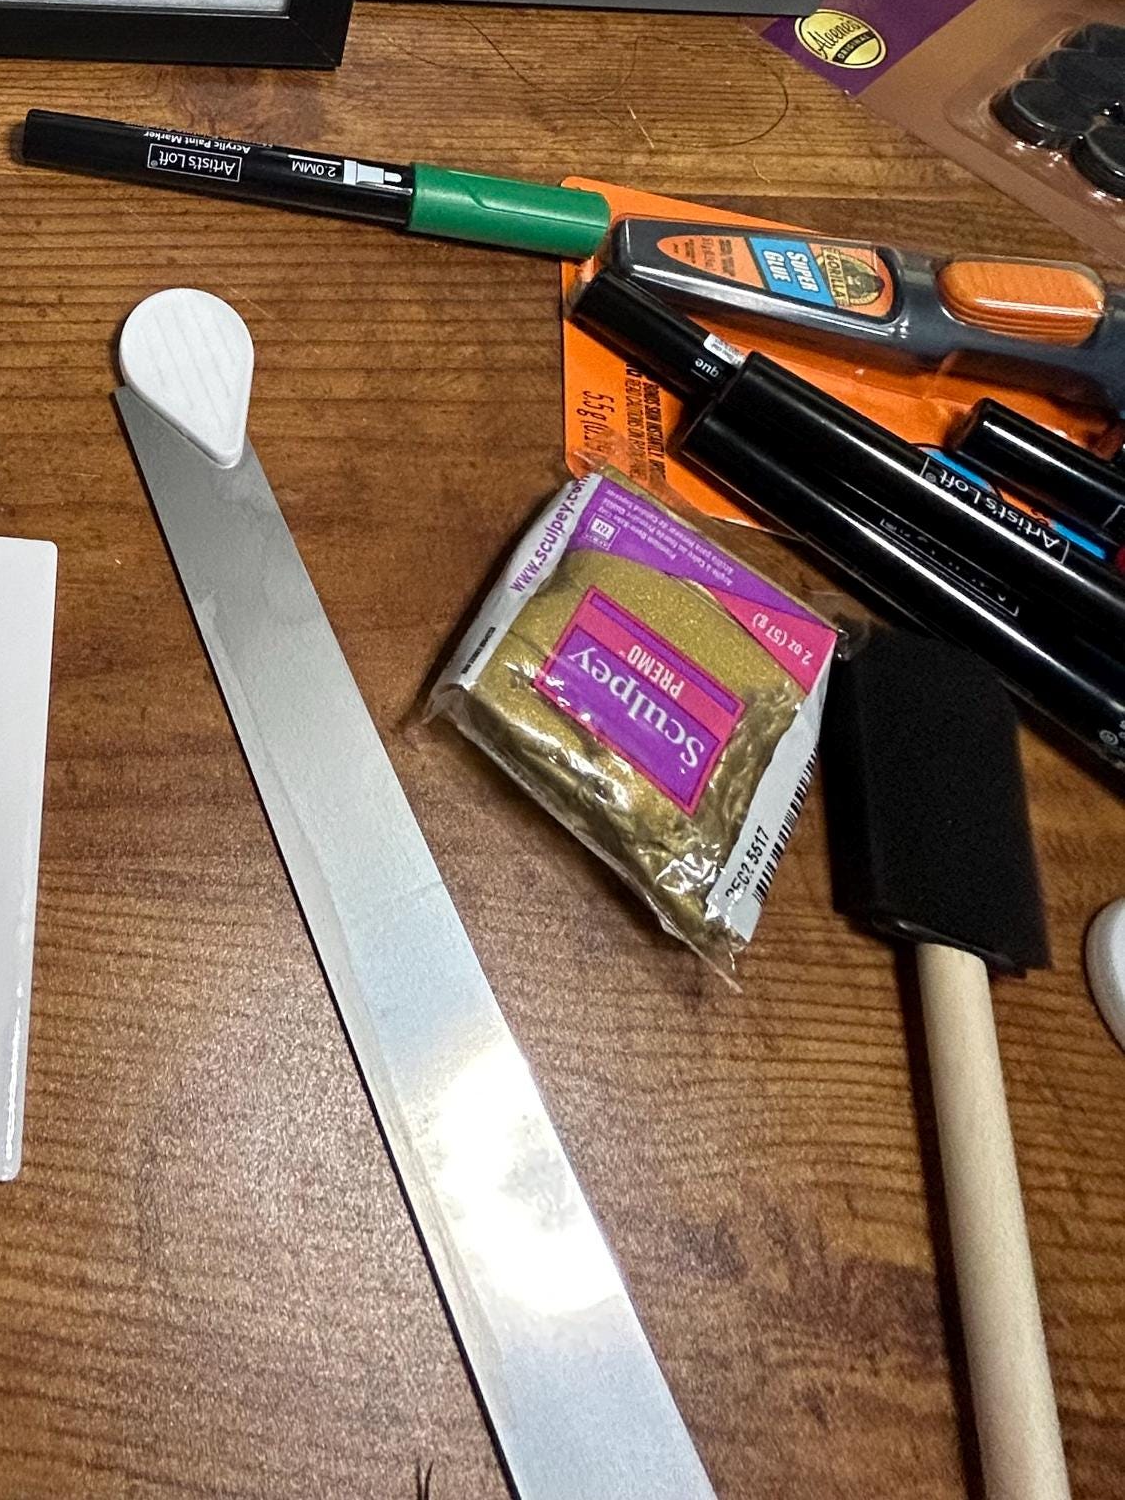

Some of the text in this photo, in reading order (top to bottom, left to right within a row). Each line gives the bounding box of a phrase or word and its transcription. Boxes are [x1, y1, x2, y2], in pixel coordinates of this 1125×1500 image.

[807, 16, 865, 60] Aleene's
[143, 130, 183, 143] Marker
[184, 137, 212, 148] Paint
[213, 141, 251, 154] Acrylic
[188, 155, 236, 176] Artist's
[763, 250, 791, 283] GLUE
[786, 251, 819, 293] SUPER
[826, 251, 847, 299] GORILLA
[510, 475, 590, 593] www.sculpey.com
[985, 496, 1061, 549] Artist's
[764, 619, 787, 647] (57
[786, 640, 801, 655] oz
[626, 644, 686, 700] PREMO
[801, 649, 814, 666] 2
[570, 646, 705, 768] Sculpey
[746, 825, 770, 865] 5517
